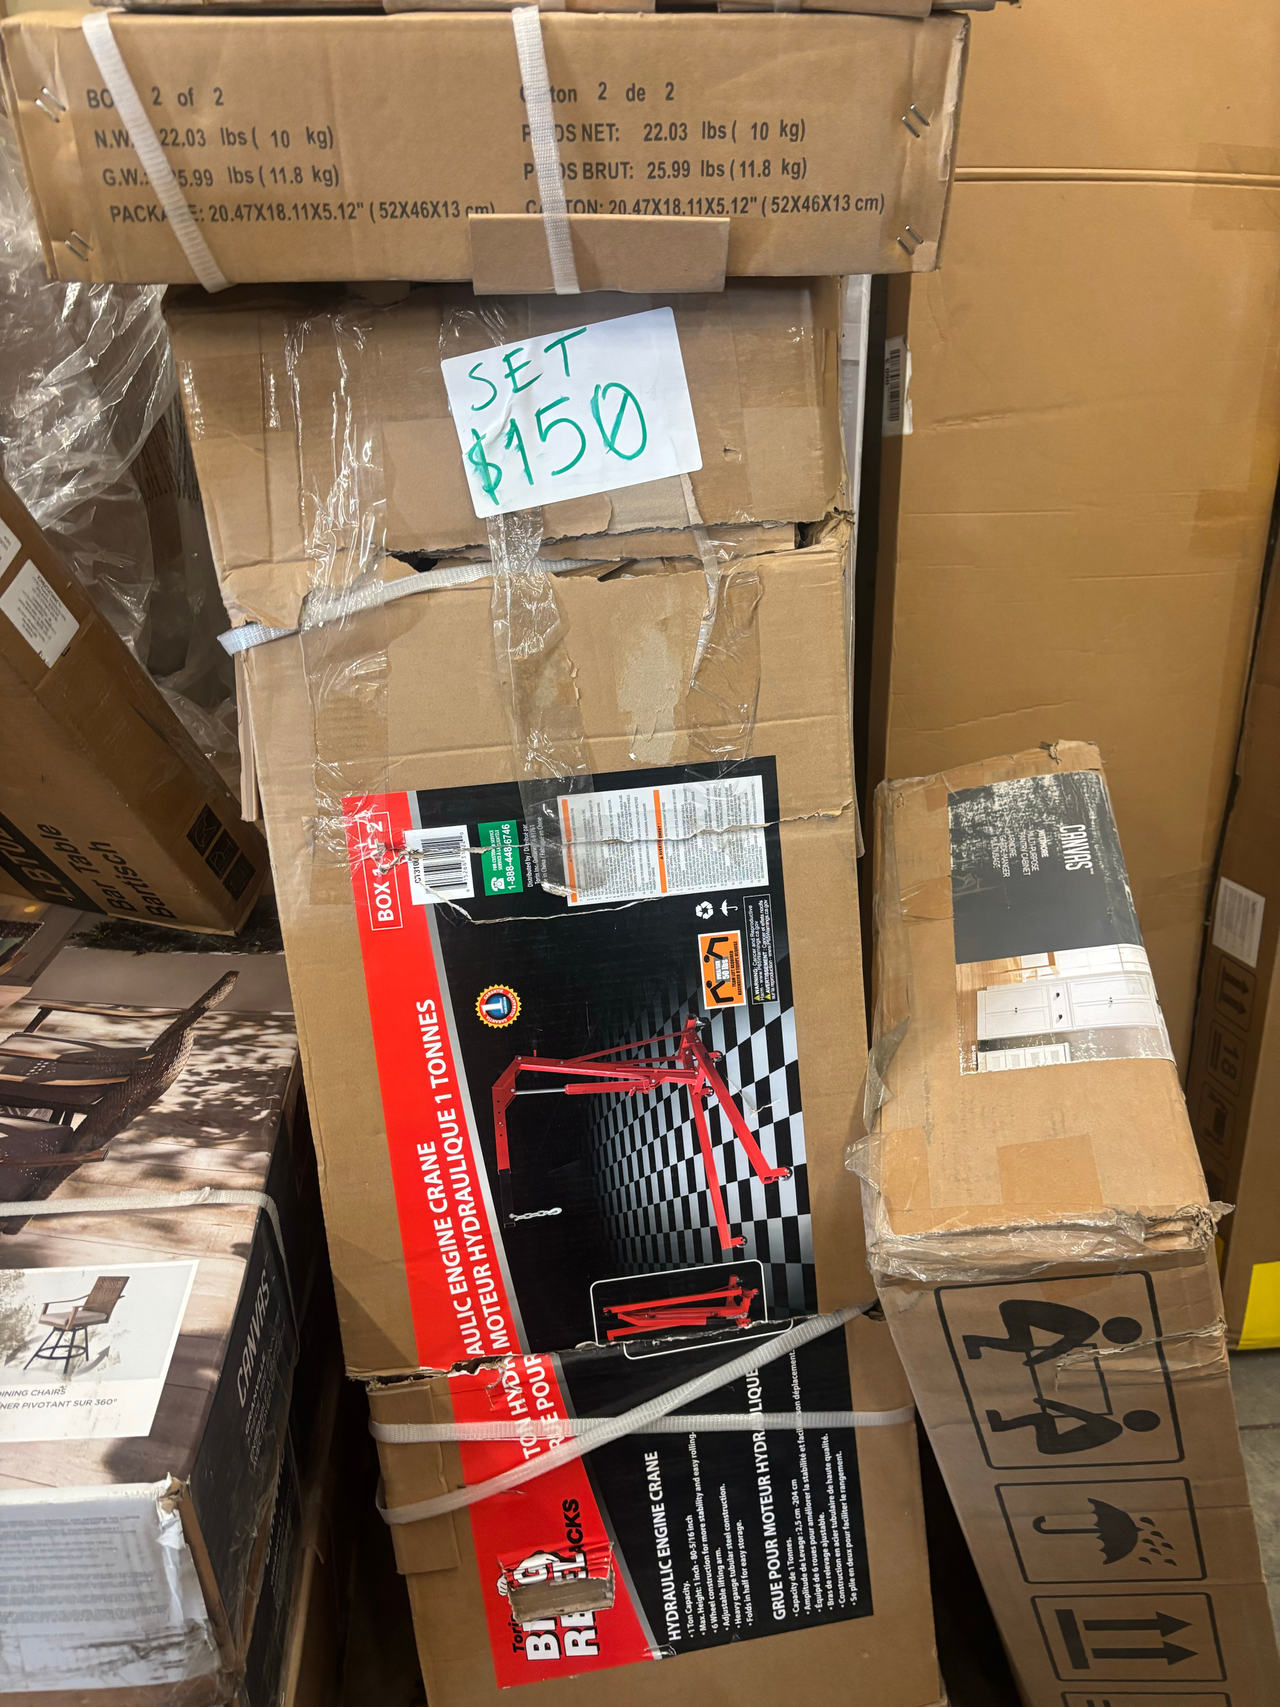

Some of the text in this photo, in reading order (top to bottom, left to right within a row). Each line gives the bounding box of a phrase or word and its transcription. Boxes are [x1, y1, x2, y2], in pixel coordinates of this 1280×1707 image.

[86, 87, 224, 109] BO 2 of 2
[598, 82, 607, 101] 2
[625, 82, 645, 102] de
[665, 82, 674, 101] 2
[160, 128, 206, 147] 22.03
[270, 129, 290, 148] 10
[306, 125, 334, 149] kg)
[522, 118, 806, 143] PDS NET: 22.03 10 kg)
[171, 168, 213, 187] 5.99
[312, 165, 339, 187] kg)
[582, 161, 633, 180] BRUT:
[647, 159, 690, 180] 25.99
[781, 158, 807, 181] kg)
[111, 204, 206, 224] PACKE:
[210, 201, 365, 224] 20.47X18.11X5.12"
[526, 199, 603, 215] CTON:
[608, 197, 757, 216] 20.47X18.11X5.12"
[855, 194, 885, 214] cm)
[469, 328, 586, 411] SET
[468, 383, 647, 505] $150
[366, 820, 383, 834] 2
[501, 823, 516, 889] 1-888-448-6746
[1058, 823, 1092, 871] CANVAS
[37, 823, 137, 913] Bar Table
[89, 841, 177, 918] Bartisch
[373, 880, 394, 922] BOX
[416, 999, 449, 1089] TONNES
[434, 1094, 452, 1104] 1
[417, 1141, 448, 1213] CRANE
[437, 1108, 487, 1261] HYDRAULIQUE
[433, 1217, 468, 1295] ENGINE
[473, 1263, 510, 1349] MOTEUR
[236, 1268, 271, 1408] CANVAS
[786, 1348, 801, 1400] déplacement.
[22, 1400, 71, 1409] PIVOTANT
[31, 1388, 66, 1396] CHAIRS
[794, 1400, 802, 1415] son
[686, 1430, 697, 1458] rolling.
[799, 1444, 806, 1452] et
[692, 1459, 700, 1476] easy
[799, 1453, 809, 1483] stabilité
[835, 1451, 847, 1493] rangement.
[692, 1477, 701, 1491] and
[745, 1367, 786, 1620] GRUE POUR MOTEUR HYDRLIQUE
[791, 1479, 798, 1490] cm
[802, 1483, 810, 1491] la
[695, 1492, 705, 1522] stability
[795, 1508, 801, 1519] cm
[804, 1492, 814, 1527] améliorer
[821, 1433, 846, 1604] Construction en acier tubulaire de haute qualité.
[841, 1502, 850, 1530] faciliter
[561, 1497, 584, 1552] ACKS
[685, 1515, 694, 1531] inch
[700, 1523, 708, 1542] more
[817, 1512, 829, 1547] ajustable.
[644, 1451, 681, 1641] HYDRAULIC ENGINE CRANE
[687, 1531, 698, 1560] 80-5/16
[701, 1543, 709, 1554] for
[809, 1527, 818, 1545] pour
[844, 1530, 853, 1548] pour
[719, 1483, 742, 1625] Heavy gauge tubular steel construction.
[786, 1537, 794, 1566] Tonnes.
[798, 1536, 806, 1562] Levage
[810, 1546, 818, 1566] roues
[846, 1548, 854, 1567] deux
[691, 1564, 700, 1581] inch
[736, 1520, 753, 1622] Folds in half for easy storage.
[788, 1571, 796, 1581] de
[799, 1562, 807, 1572] de
[823, 1548, 831, 1579] relevage
[848, 1567, 855, 1577] en
[703, 1555, 715, 1600] construction
[717, 1565, 725, 1588] lifting
[812, 1573, 820, 1582] de
[825, 1580, 833, 1589] de
[848, 1578, 858, 1592] plie
[682, 1581, 693, 1614] Capacity.
[695, 1586, 705, 1614] Height:
[790, 1582, 800, 1613] Capacity
[800, 1573, 812, 1610] Amplitude
[813, 1583, 824, 1608] Équipé
[850, 1592, 857, 1601] Se
[708, 1600, 718, 1624] Wheel
[719, 1588, 731, 1626] Adjustable
[699, 1613, 707, 1631] Max.
